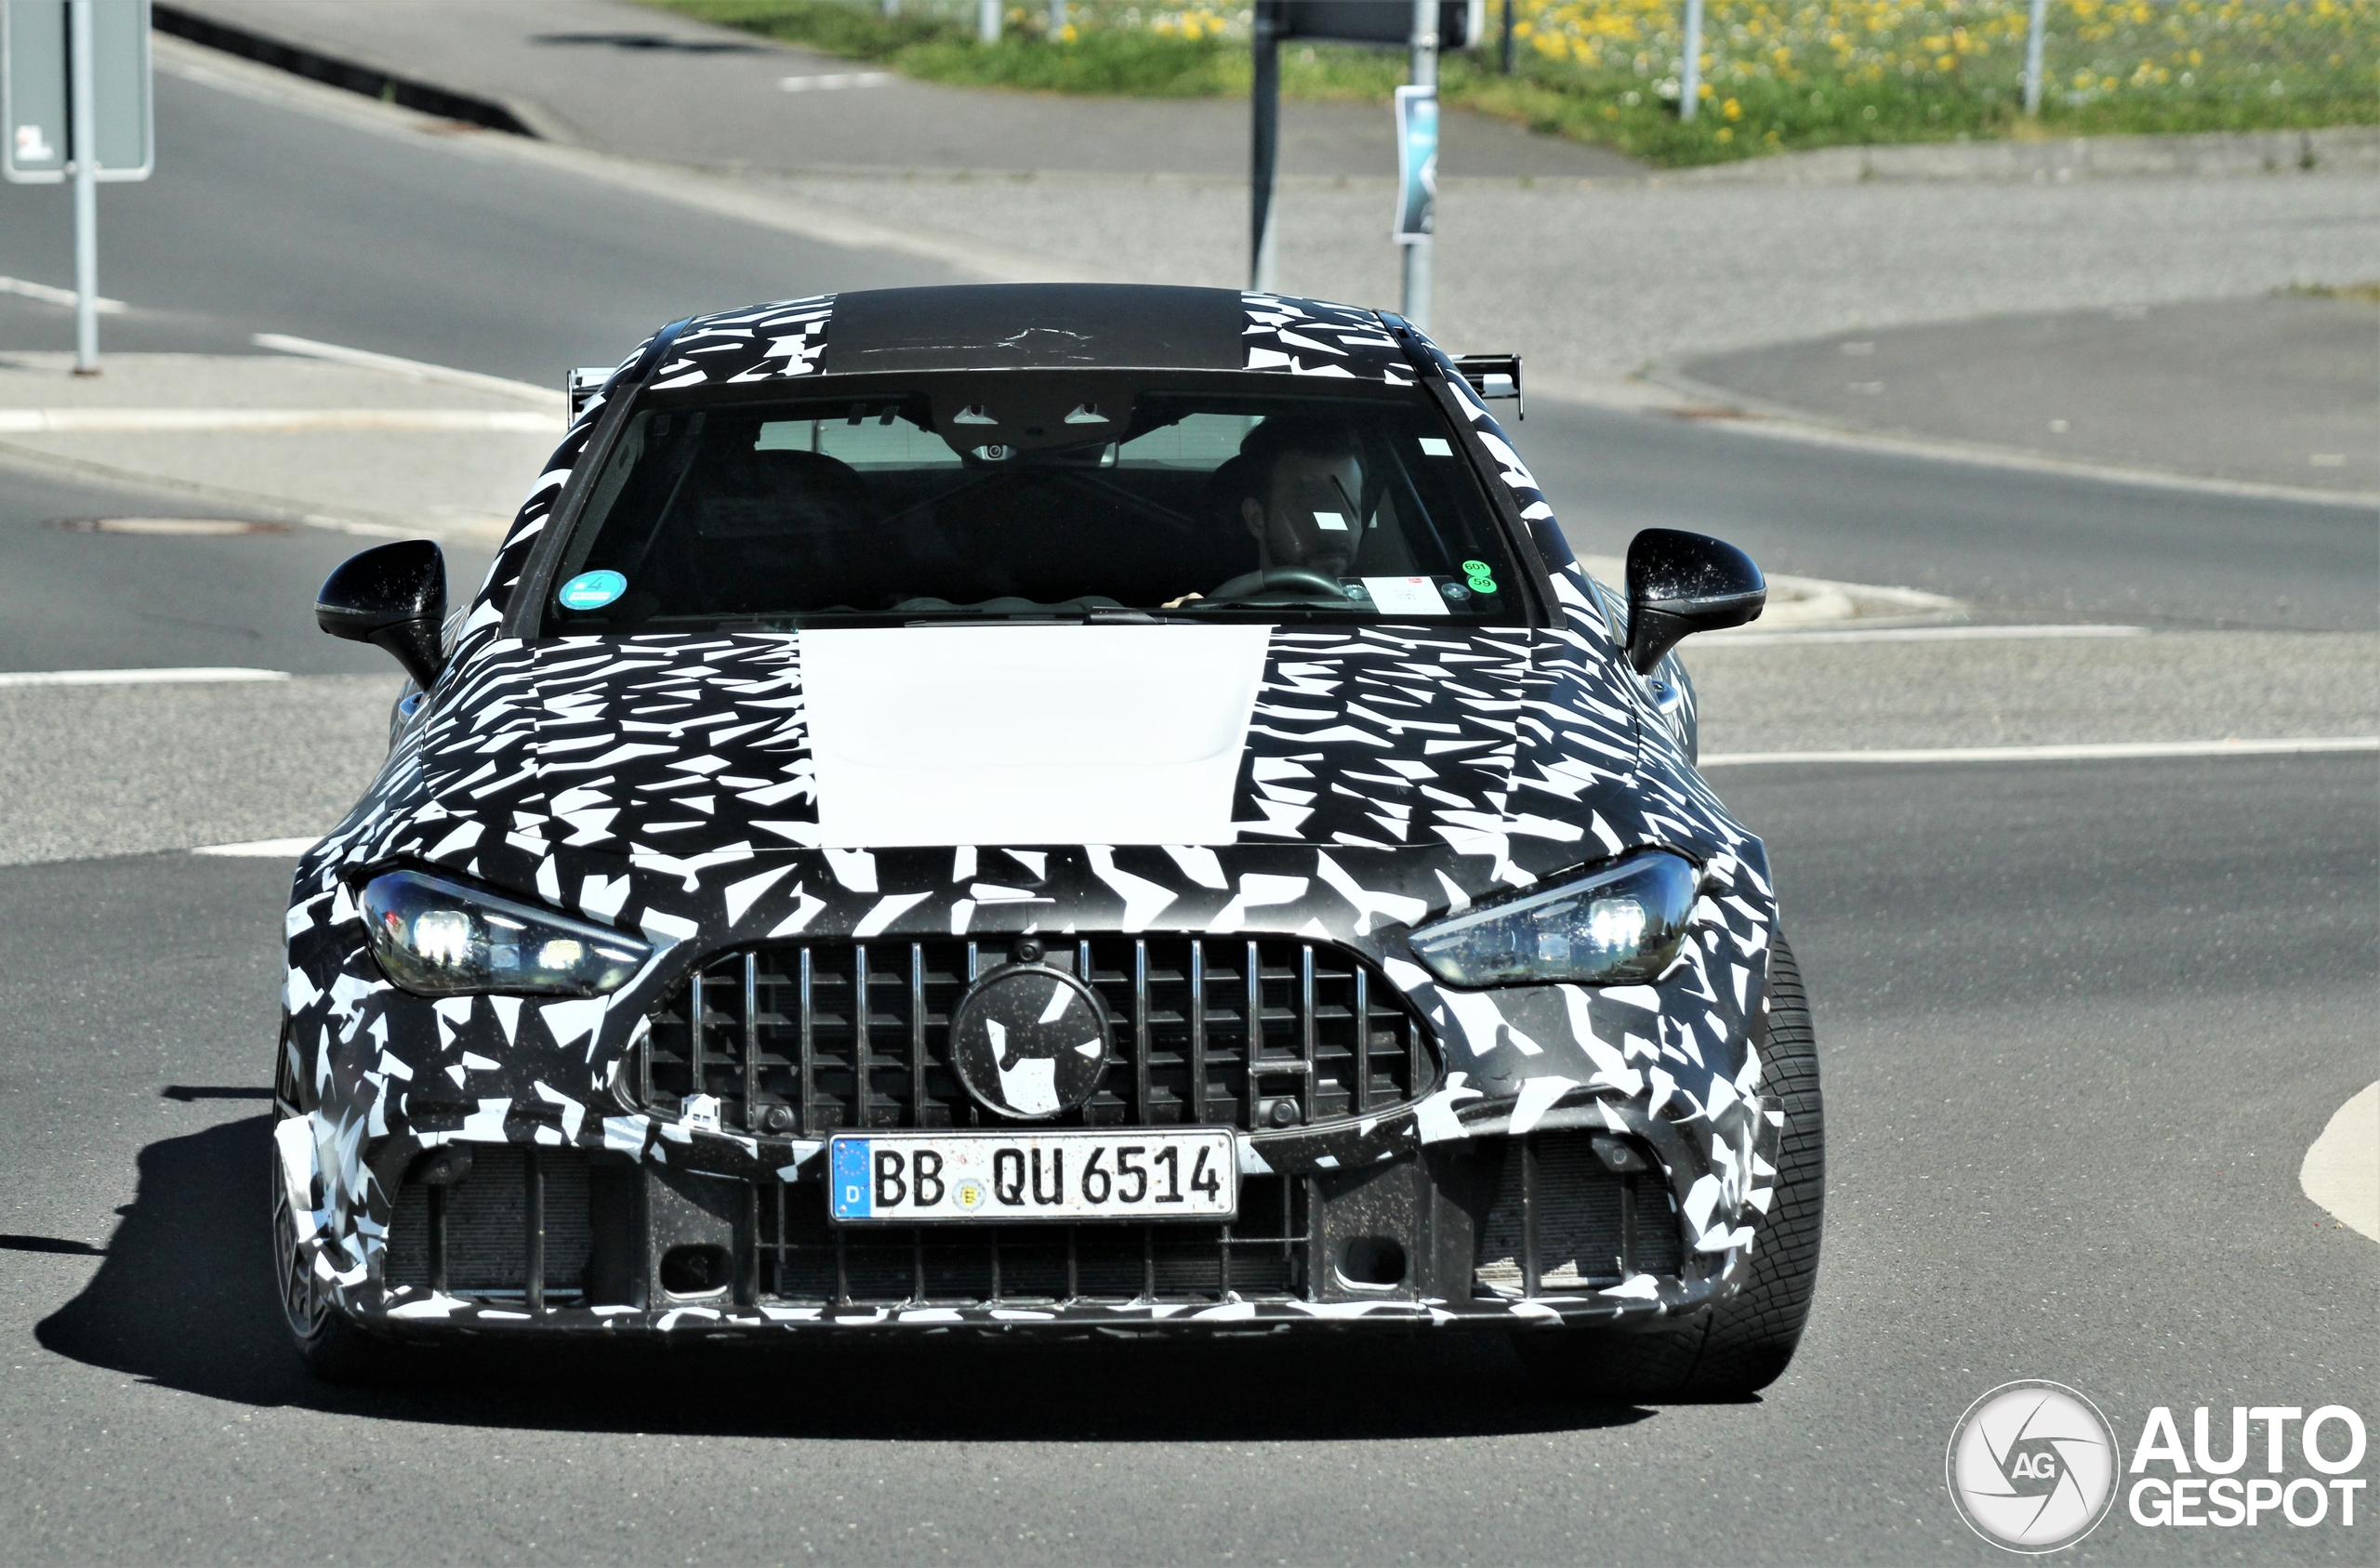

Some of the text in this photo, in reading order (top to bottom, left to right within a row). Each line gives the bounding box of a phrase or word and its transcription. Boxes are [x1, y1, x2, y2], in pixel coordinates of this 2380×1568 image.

[587, 575, 604, 590] 4
[1474, 578, 1491, 587] 59
[874, 1145, 1221, 1207] BB QU 6514
[846, 1185, 860, 1204] D
